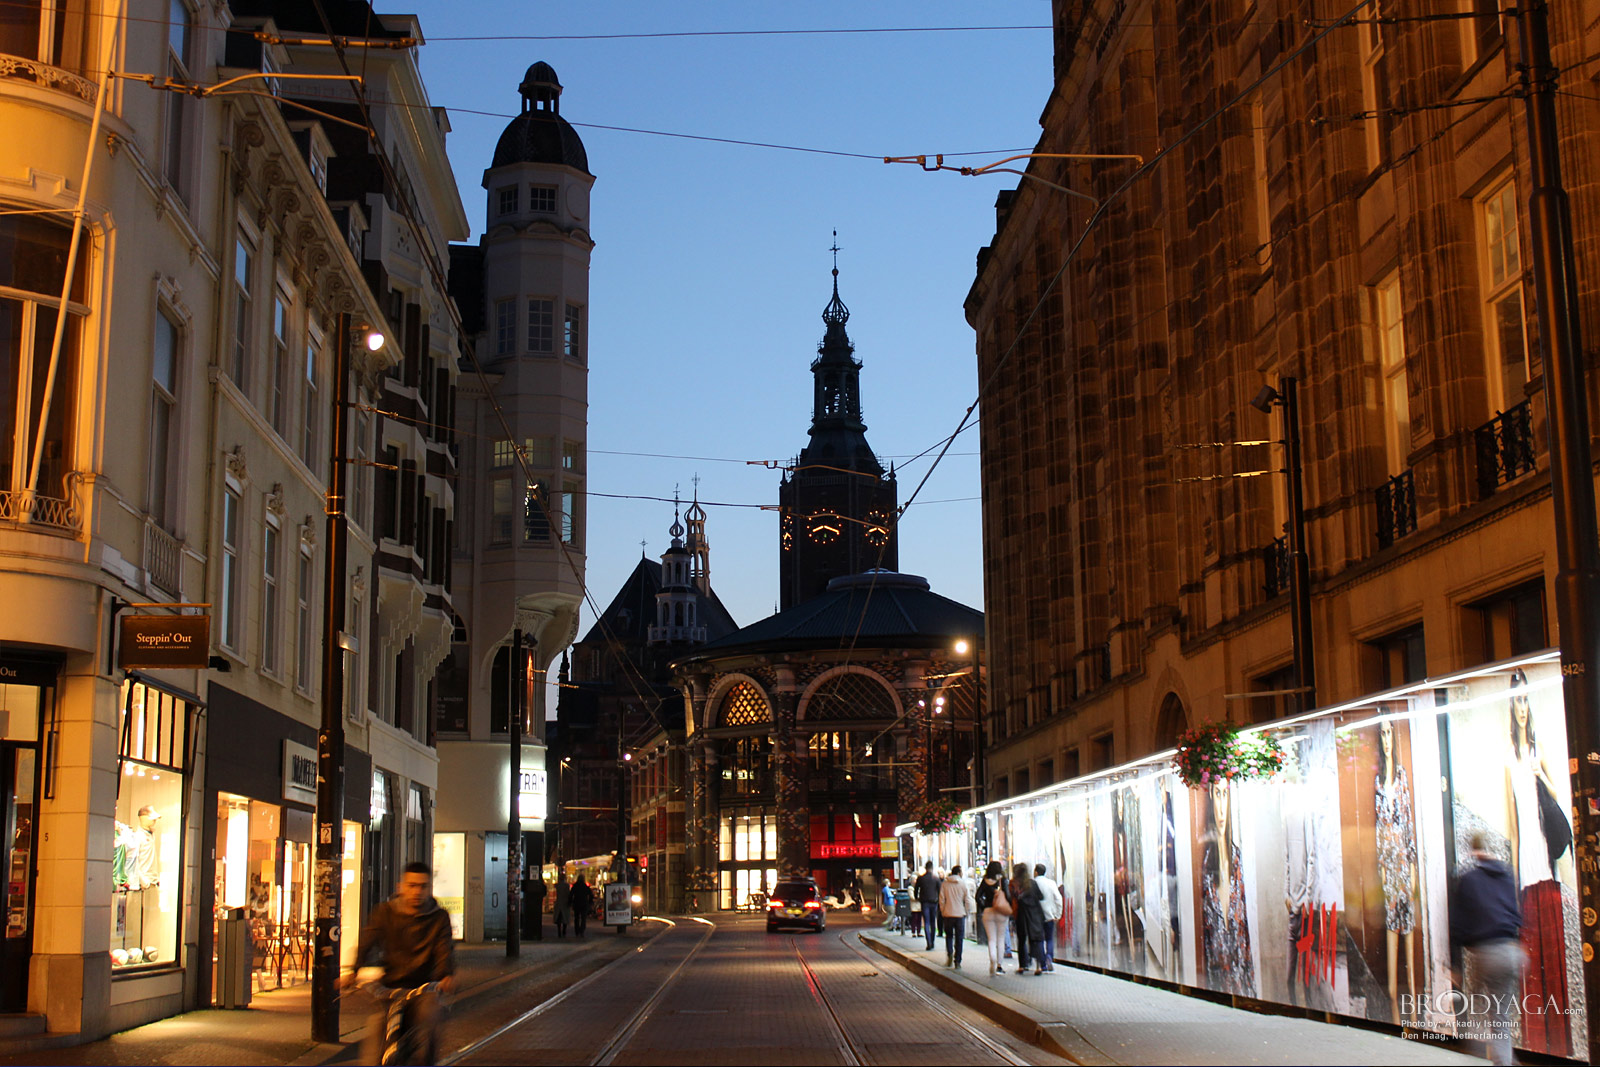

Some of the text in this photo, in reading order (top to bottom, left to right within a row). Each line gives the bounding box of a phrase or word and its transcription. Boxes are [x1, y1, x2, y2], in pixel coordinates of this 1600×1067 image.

[136, 632, 192, 645] Steppin' Out
[0, 666, 17, 677] Out
[45, 832, 49, 842] 5
